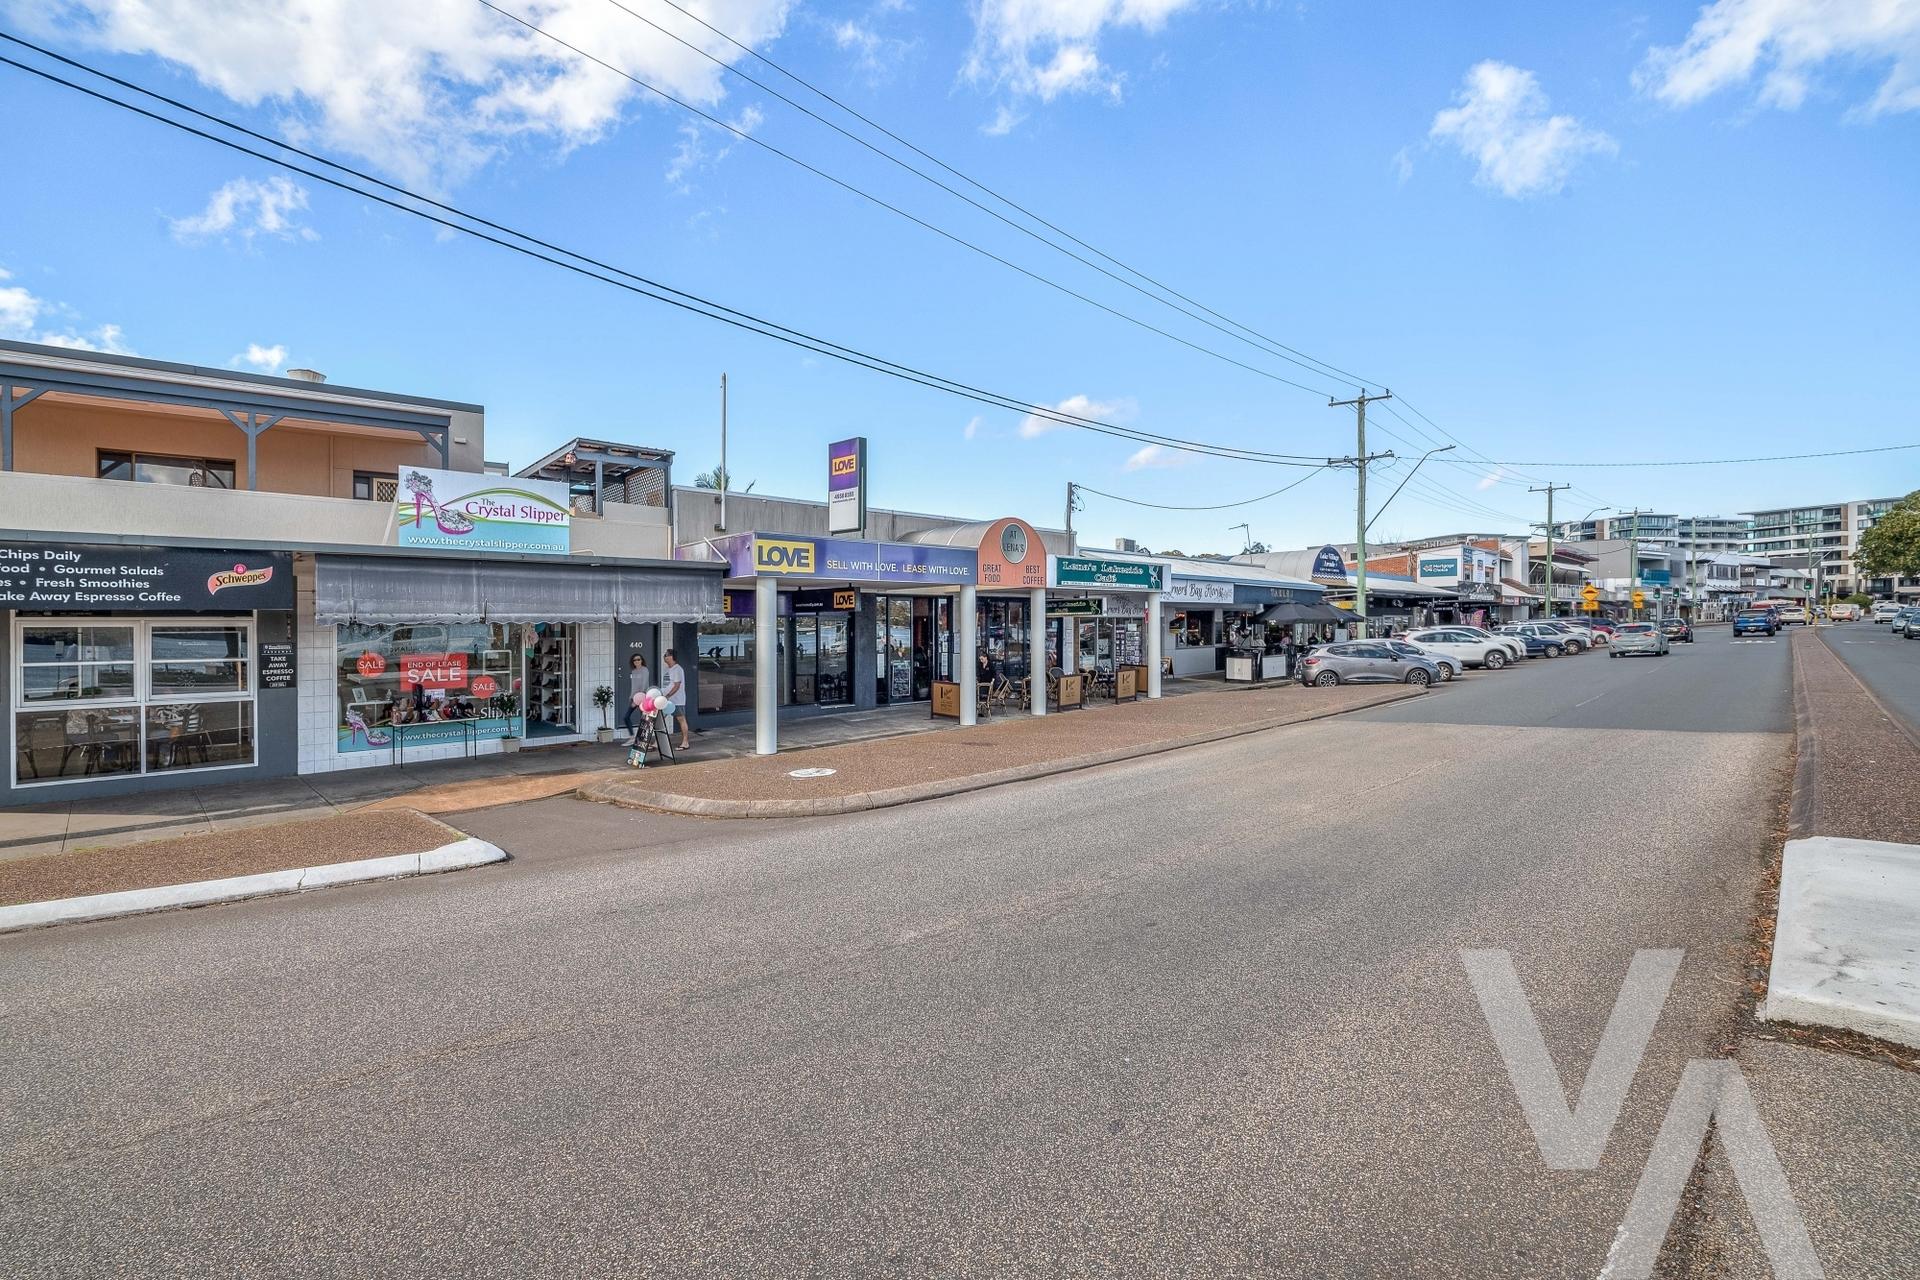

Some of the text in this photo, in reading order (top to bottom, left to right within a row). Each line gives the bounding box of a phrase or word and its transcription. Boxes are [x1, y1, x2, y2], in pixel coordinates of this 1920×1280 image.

[834, 458, 854, 472] LOVE
[481, 498, 496, 507] The
[465, 501, 566, 523] Crystal Slipper
[1009, 530, 1017, 540] AT
[407, 536, 564, 551] www.thecrystalslipper.com.au
[44, 550, 82, 563] Daily
[757, 545, 810, 567] LOVE
[54, 565, 116, 575] Gourmet
[120, 566, 165, 576] Salads
[826, 560, 970, 576] SELL WITH LOVE. LEASE WITH LOVE.
[983, 563, 1002, 573] GREAT
[1025, 565, 1041, 574] BEST
[36, 578, 75, 588] Fresh
[79, 579, 151, 589] Smoothies
[215, 572, 267, 587] Schweppes
[984, 574, 1001, 583] FOOD
[1023, 576, 1045, 585] COFFEE
[0, 591, 182, 603] ake Away Espresso Coffee
[836, 595, 854, 605] LOVE
[359, 661, 385, 670] SALE
[407, 667, 462, 684] SALE
[472, 683, 496, 691] SALE
